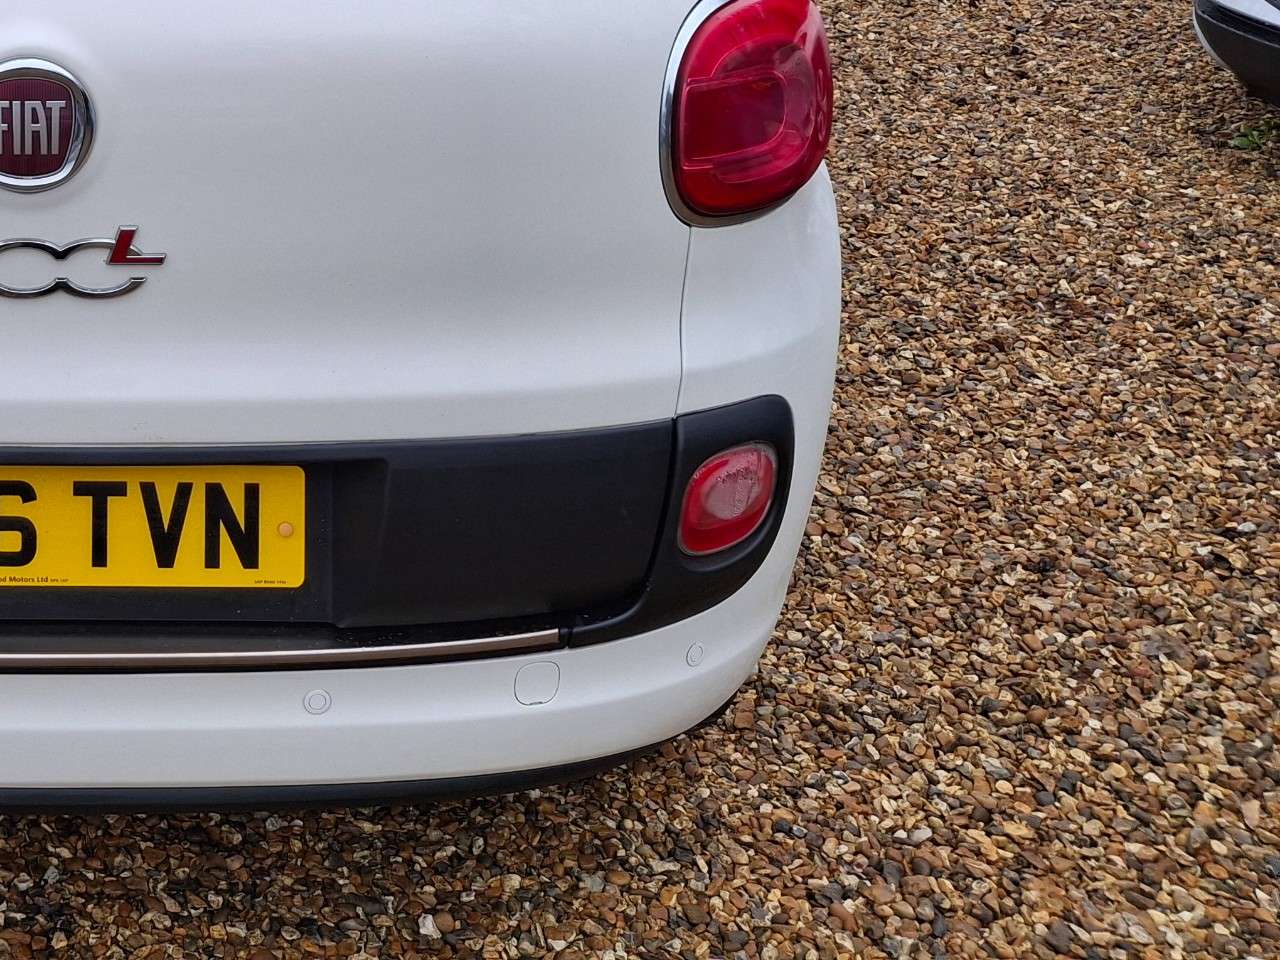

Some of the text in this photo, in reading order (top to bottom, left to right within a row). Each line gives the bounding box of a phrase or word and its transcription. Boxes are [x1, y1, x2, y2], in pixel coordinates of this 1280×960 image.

[72, 480, 261, 570] TVN
[8, 575, 35, 583] Motors
[36, 575, 49, 583] Ltd
